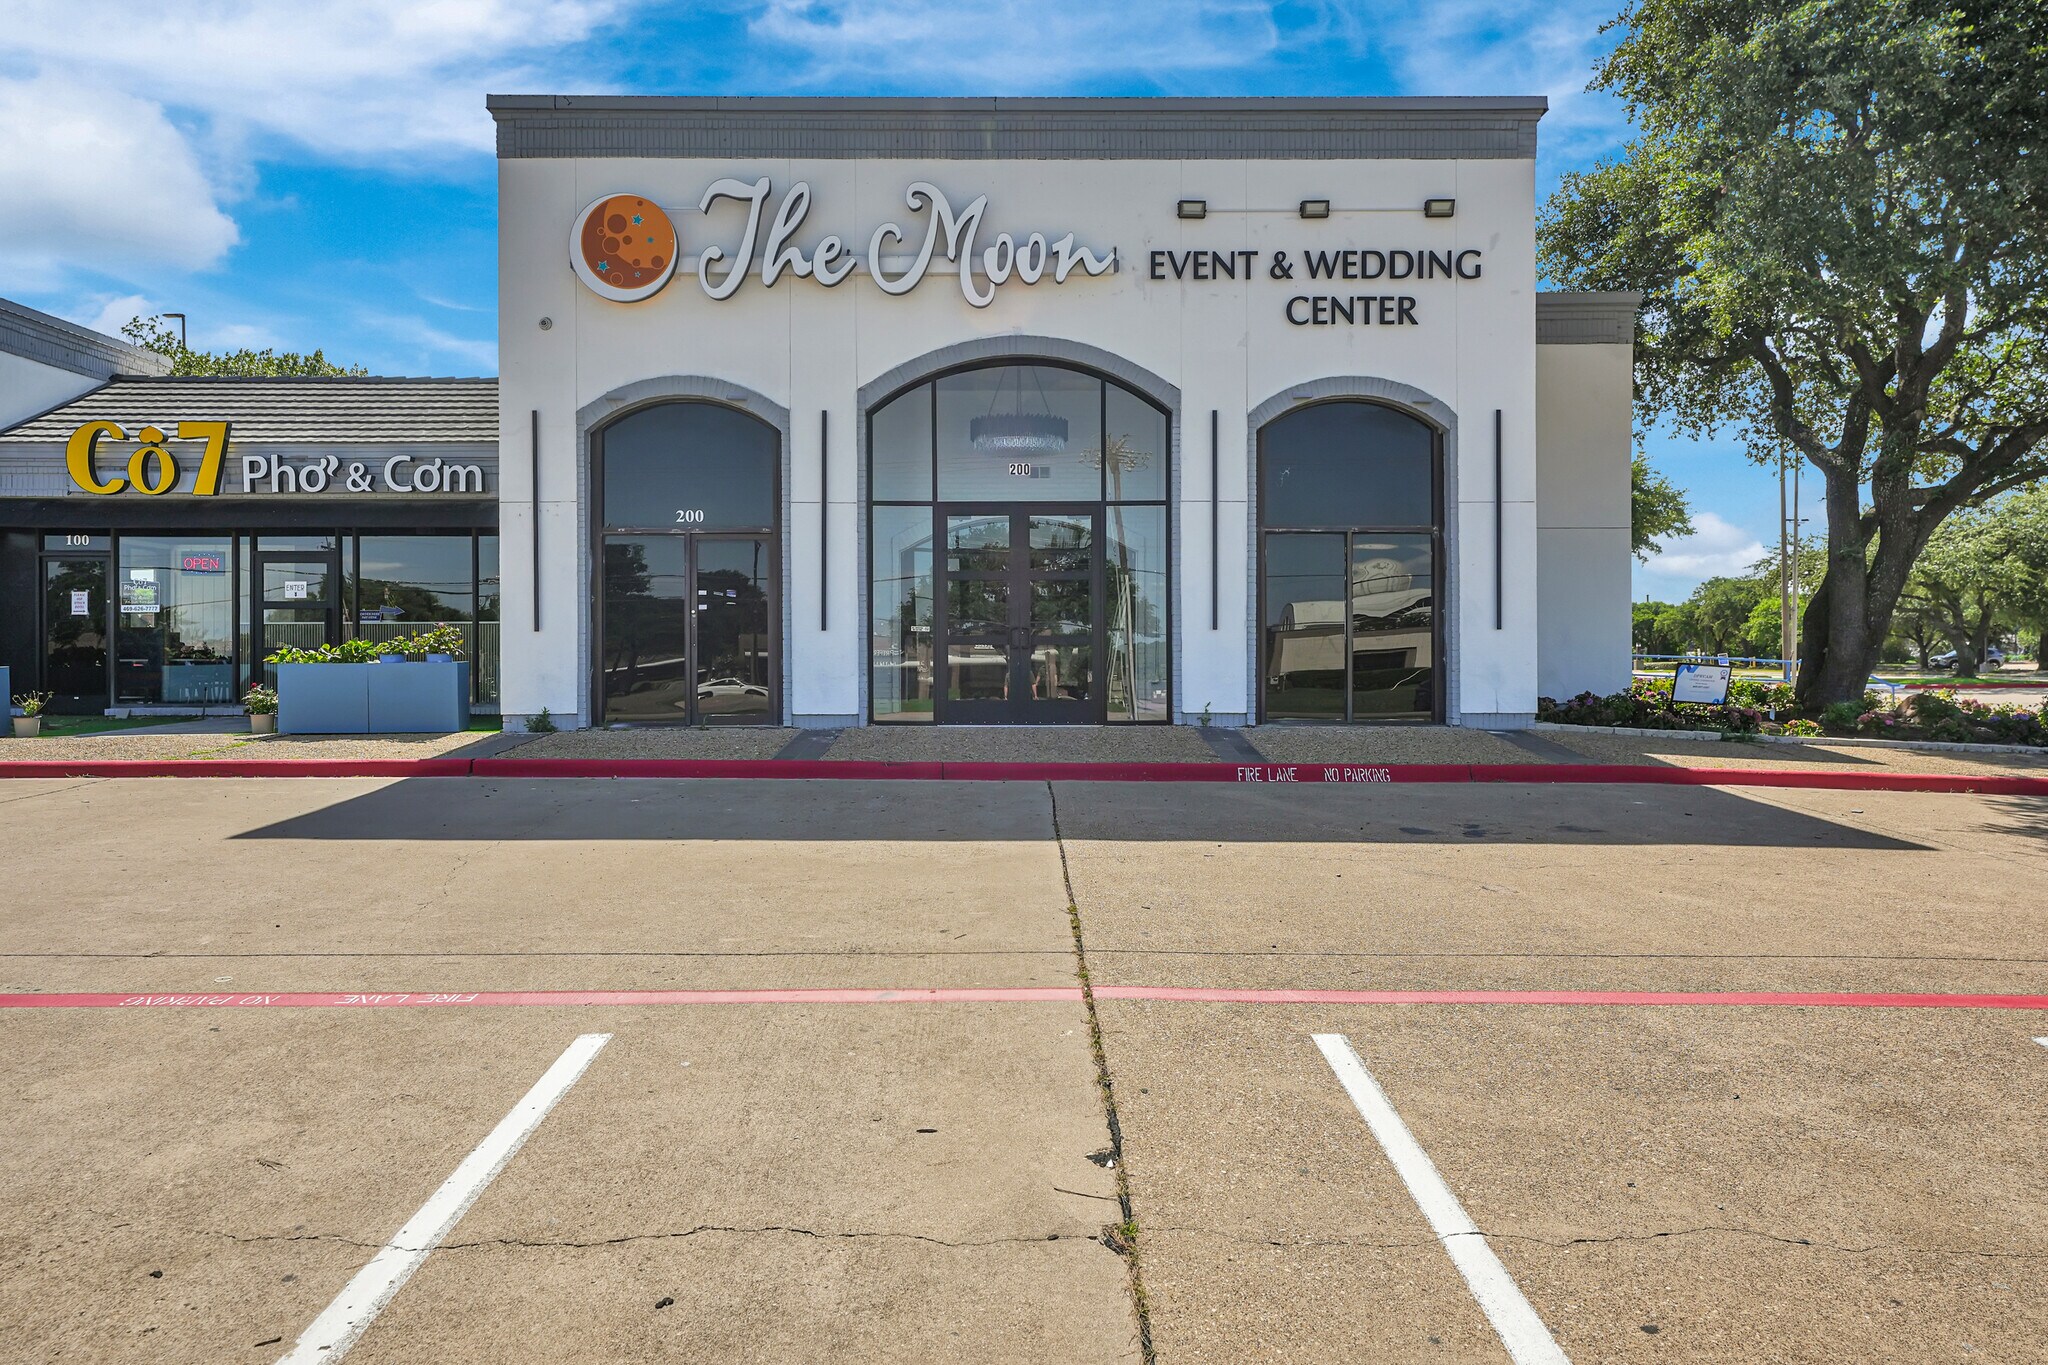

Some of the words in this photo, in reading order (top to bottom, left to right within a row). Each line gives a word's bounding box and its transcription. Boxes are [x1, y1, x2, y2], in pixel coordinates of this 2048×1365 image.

[698, 176, 857, 301] The
[868, 180, 1117, 308] Moon
[1150, 250, 1259, 281] EVENT
[1269, 250, 1295, 281] &
[1304, 249, 1483, 281] WEDDING
[1285, 295, 1420, 326] CENTER
[1009, 463, 1031, 476] 200
[347, 461, 377, 493] &
[675, 509, 704, 523] 200
[65, 534, 90, 547] 100
[183, 557, 219, 571] OPEN
[285, 584, 305, 592] ENTER
[1237, 767, 1263, 782] FIRE
[1267, 767, 1299, 782] LANE
[1323, 767, 1340, 783] NO
[1343, 767, 1391, 783] PARKING
[118, 995, 235, 1006] PARKING
[238, 995, 281, 1005] NO
[334, 994, 411, 1004] LANE
[416, 993, 480, 1003] FIRE
